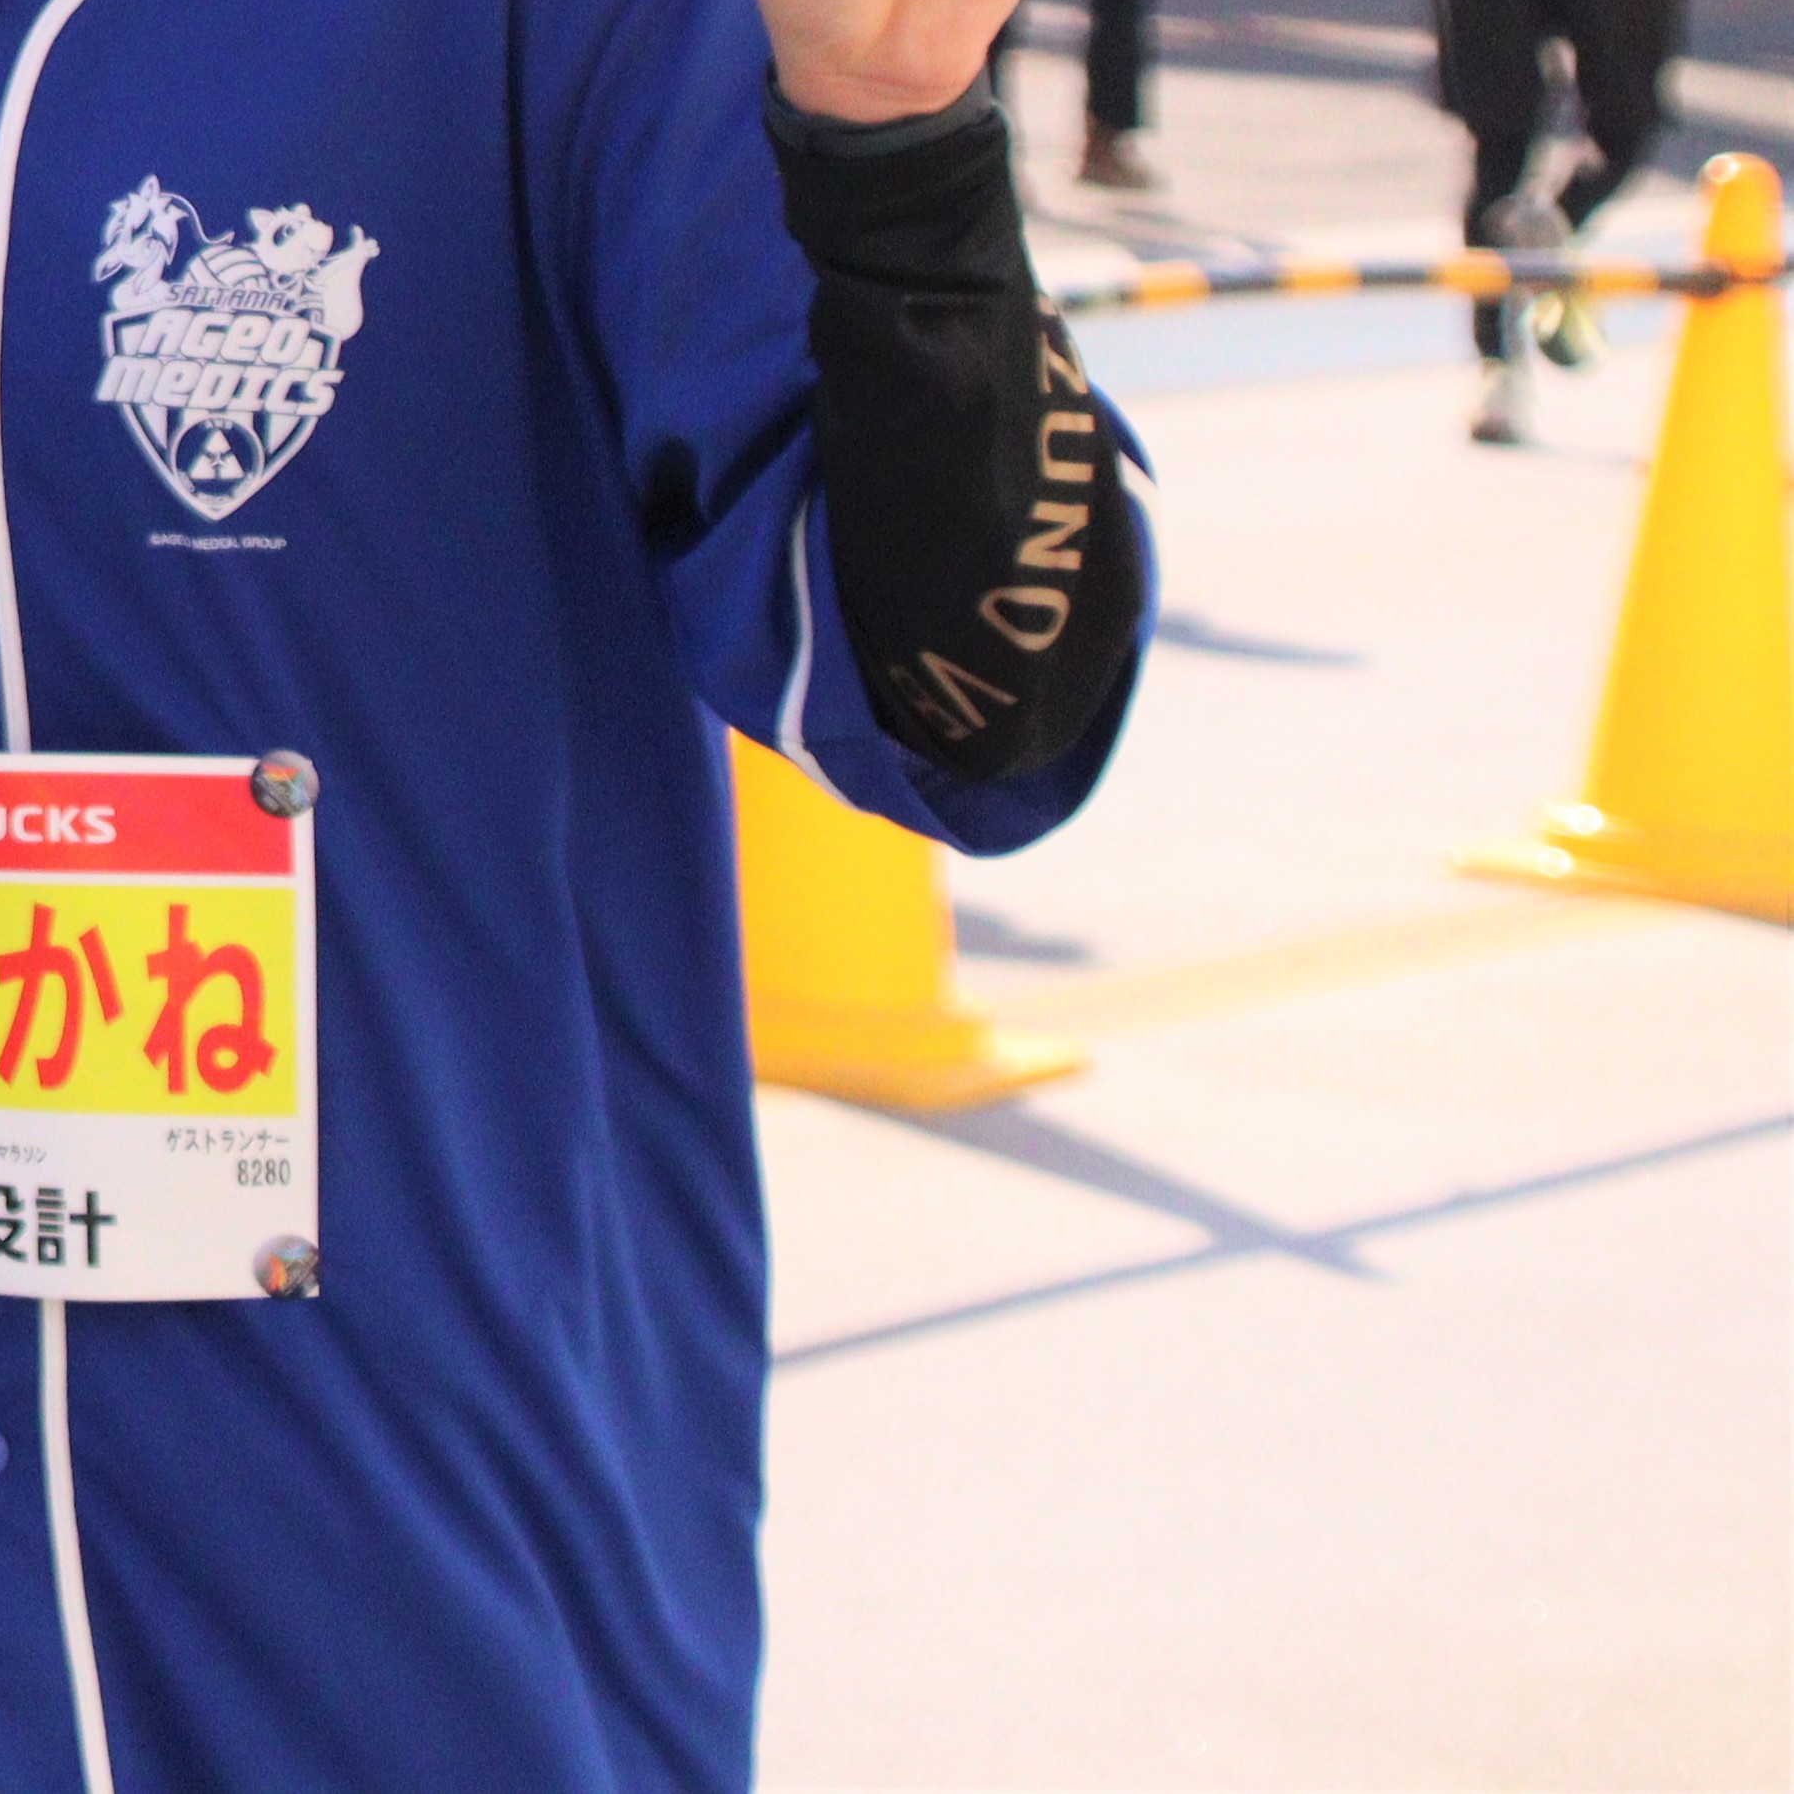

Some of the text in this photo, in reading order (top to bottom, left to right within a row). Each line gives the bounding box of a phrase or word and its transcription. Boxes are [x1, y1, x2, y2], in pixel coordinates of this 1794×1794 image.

[166, 284, 288, 311] SAITAMA
[241, 535, 288, 551] GROUP
[166, 1127, 291, 1154] ゲストランナー
[237, 1158, 291, 1186] 8280
